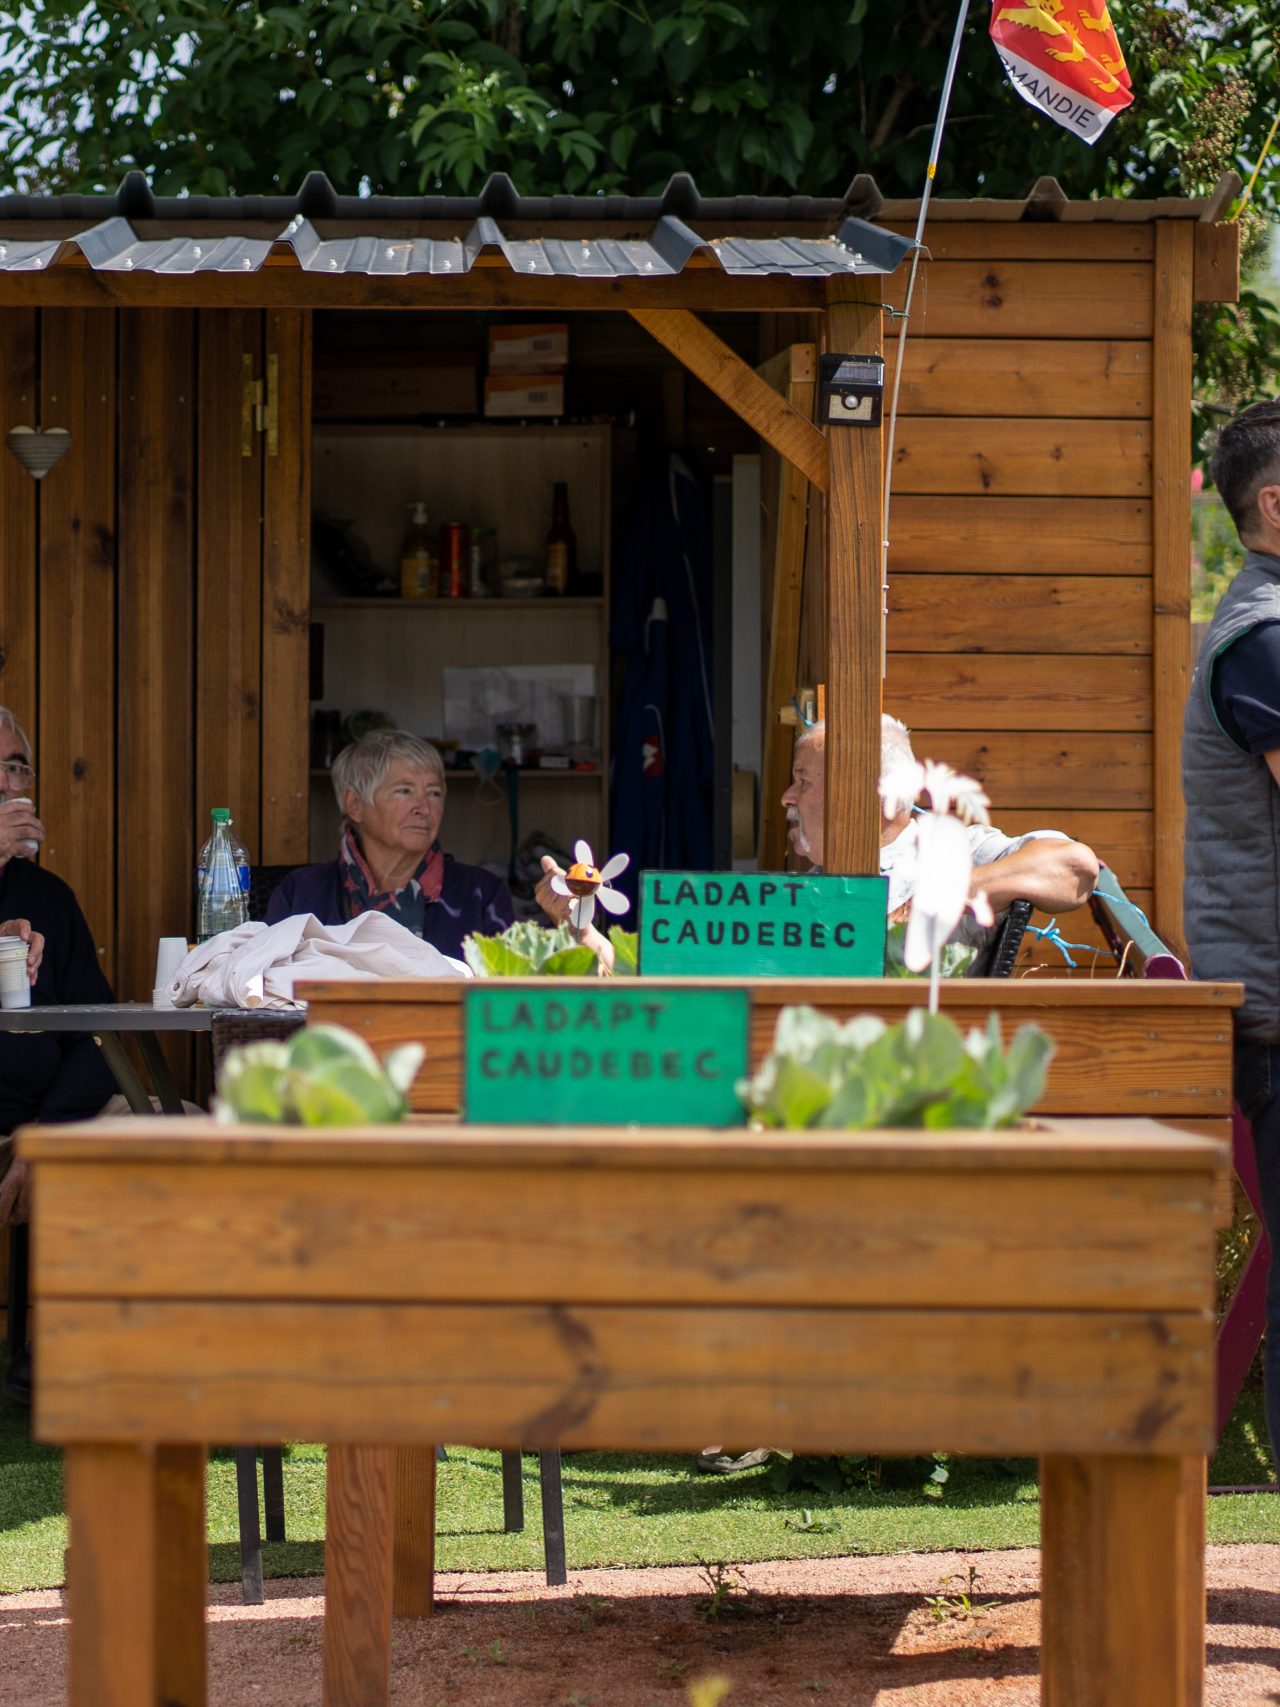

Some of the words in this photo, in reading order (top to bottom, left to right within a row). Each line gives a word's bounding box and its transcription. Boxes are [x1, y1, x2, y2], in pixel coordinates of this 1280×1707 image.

[653, 879, 804, 906] LADAPT
[651, 918, 855, 948] CAUDEBEC
[481, 999, 666, 1034] LADAPT
[479, 1048, 720, 1080] CAUDEBEC
